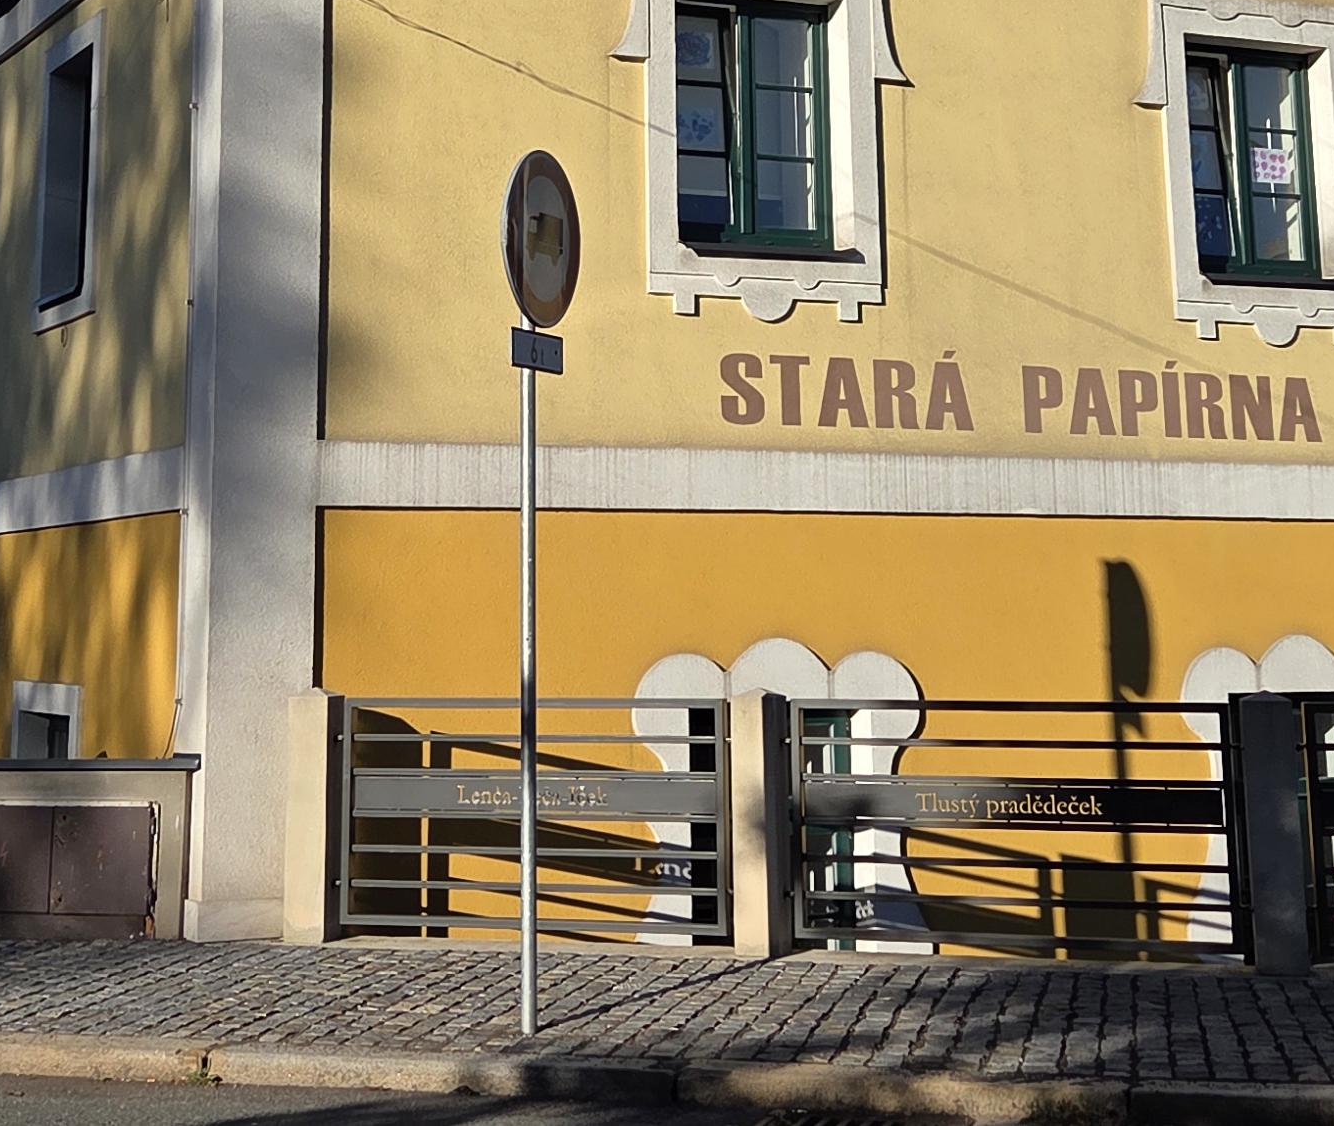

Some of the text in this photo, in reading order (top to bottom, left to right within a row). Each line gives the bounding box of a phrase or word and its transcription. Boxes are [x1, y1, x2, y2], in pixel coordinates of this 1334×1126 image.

[720, 350, 1323, 443] STARÁ PAPÍRNA
[915, 792, 1103, 819] Tlustý pradědeček
